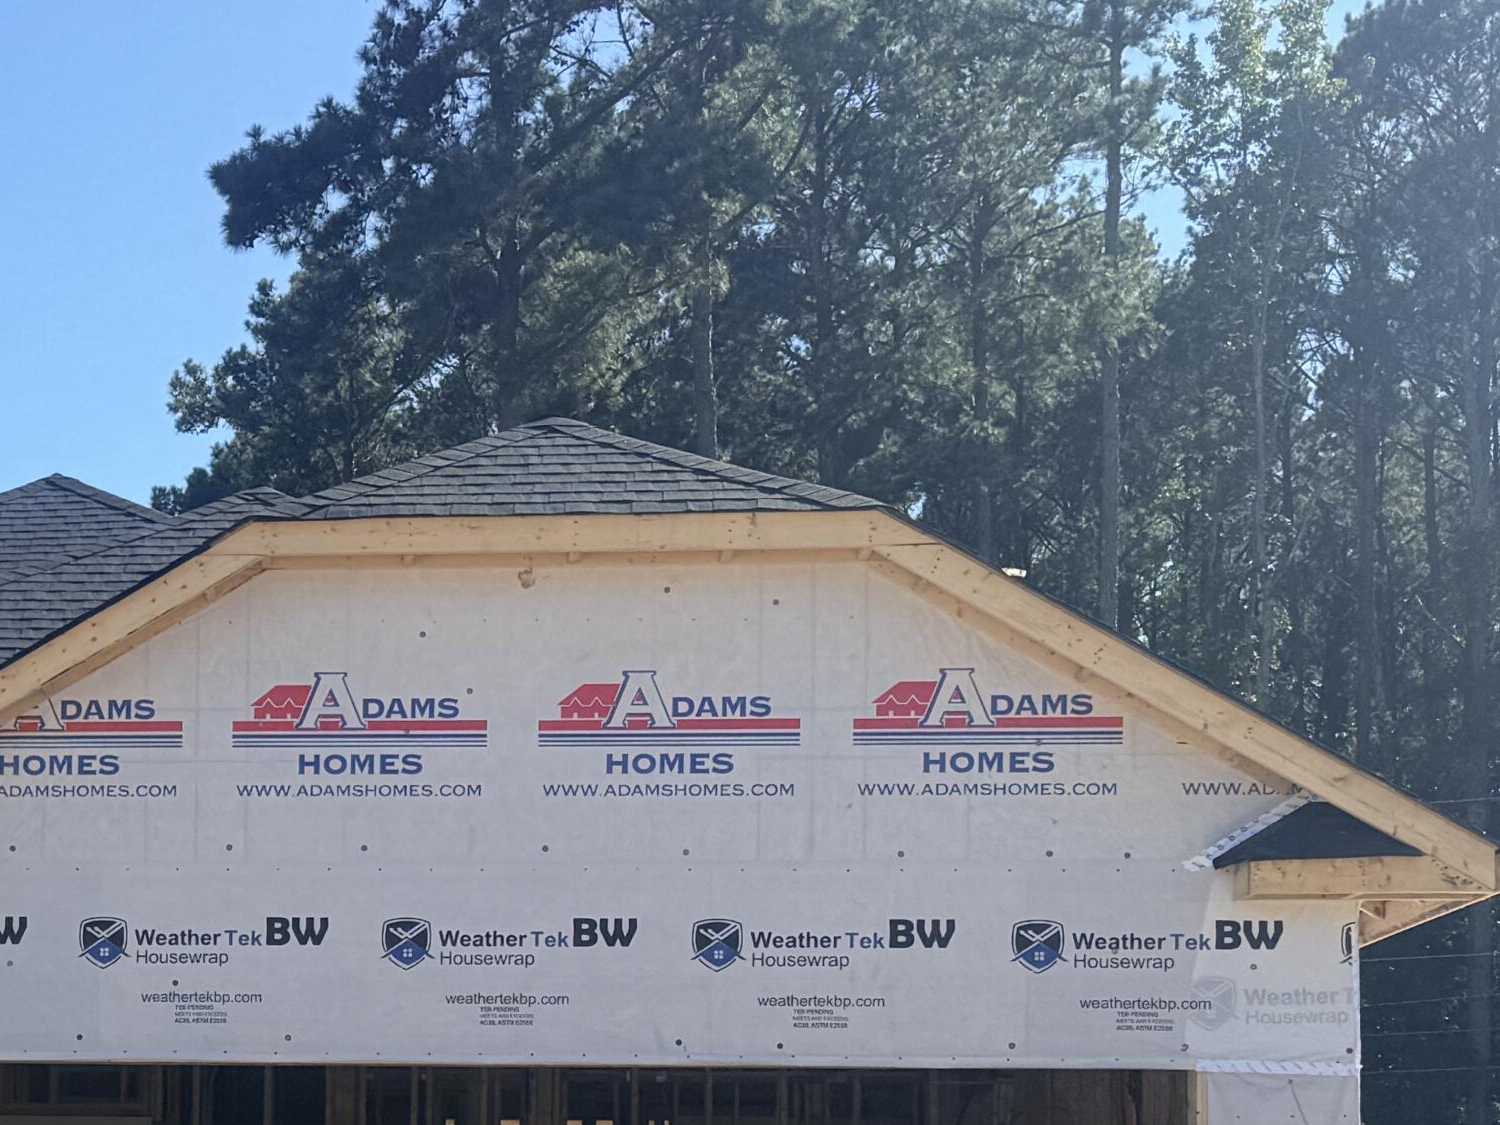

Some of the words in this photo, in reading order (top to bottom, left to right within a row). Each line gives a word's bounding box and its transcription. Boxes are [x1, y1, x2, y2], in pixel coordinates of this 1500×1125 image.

[294, 672, 460, 730] ADAMS
[603, 670, 772, 729] ADAMS
[918, 668, 1093, 727] ADAMS
[297, 754, 423, 775] HOMES
[605, 753, 734, 774] HOMES
[922, 752, 1055, 773] HOMES
[236, 784, 482, 797] WWW.ADAMSHOMES.COM
[542, 783, 794, 797] WWW.ADAMSHOMES.COM
[857, 783, 1117, 796] WWW.ADAMSHOMES.COM
[265, 916, 329, 946] BW
[572, 918, 638, 947] BW
[888, 919, 956, 949] BW
[1214, 920, 1284, 950] BW
[136, 950, 229, 966] Housewrap
[440, 951, 535, 968] Housewrap
[751, 952, 850, 970] Housewrap
[1073, 953, 1175, 972] Housewrap
[141, 990, 262, 1005] weathertekbp.com
[445, 992, 570, 1007] weathertekbp.com
[757, 994, 885, 1010] weathertekbp.com
[1080, 997, 1212, 1012] weathertekbp.com
[1245, 1008, 1349, 1026] Housewrap
